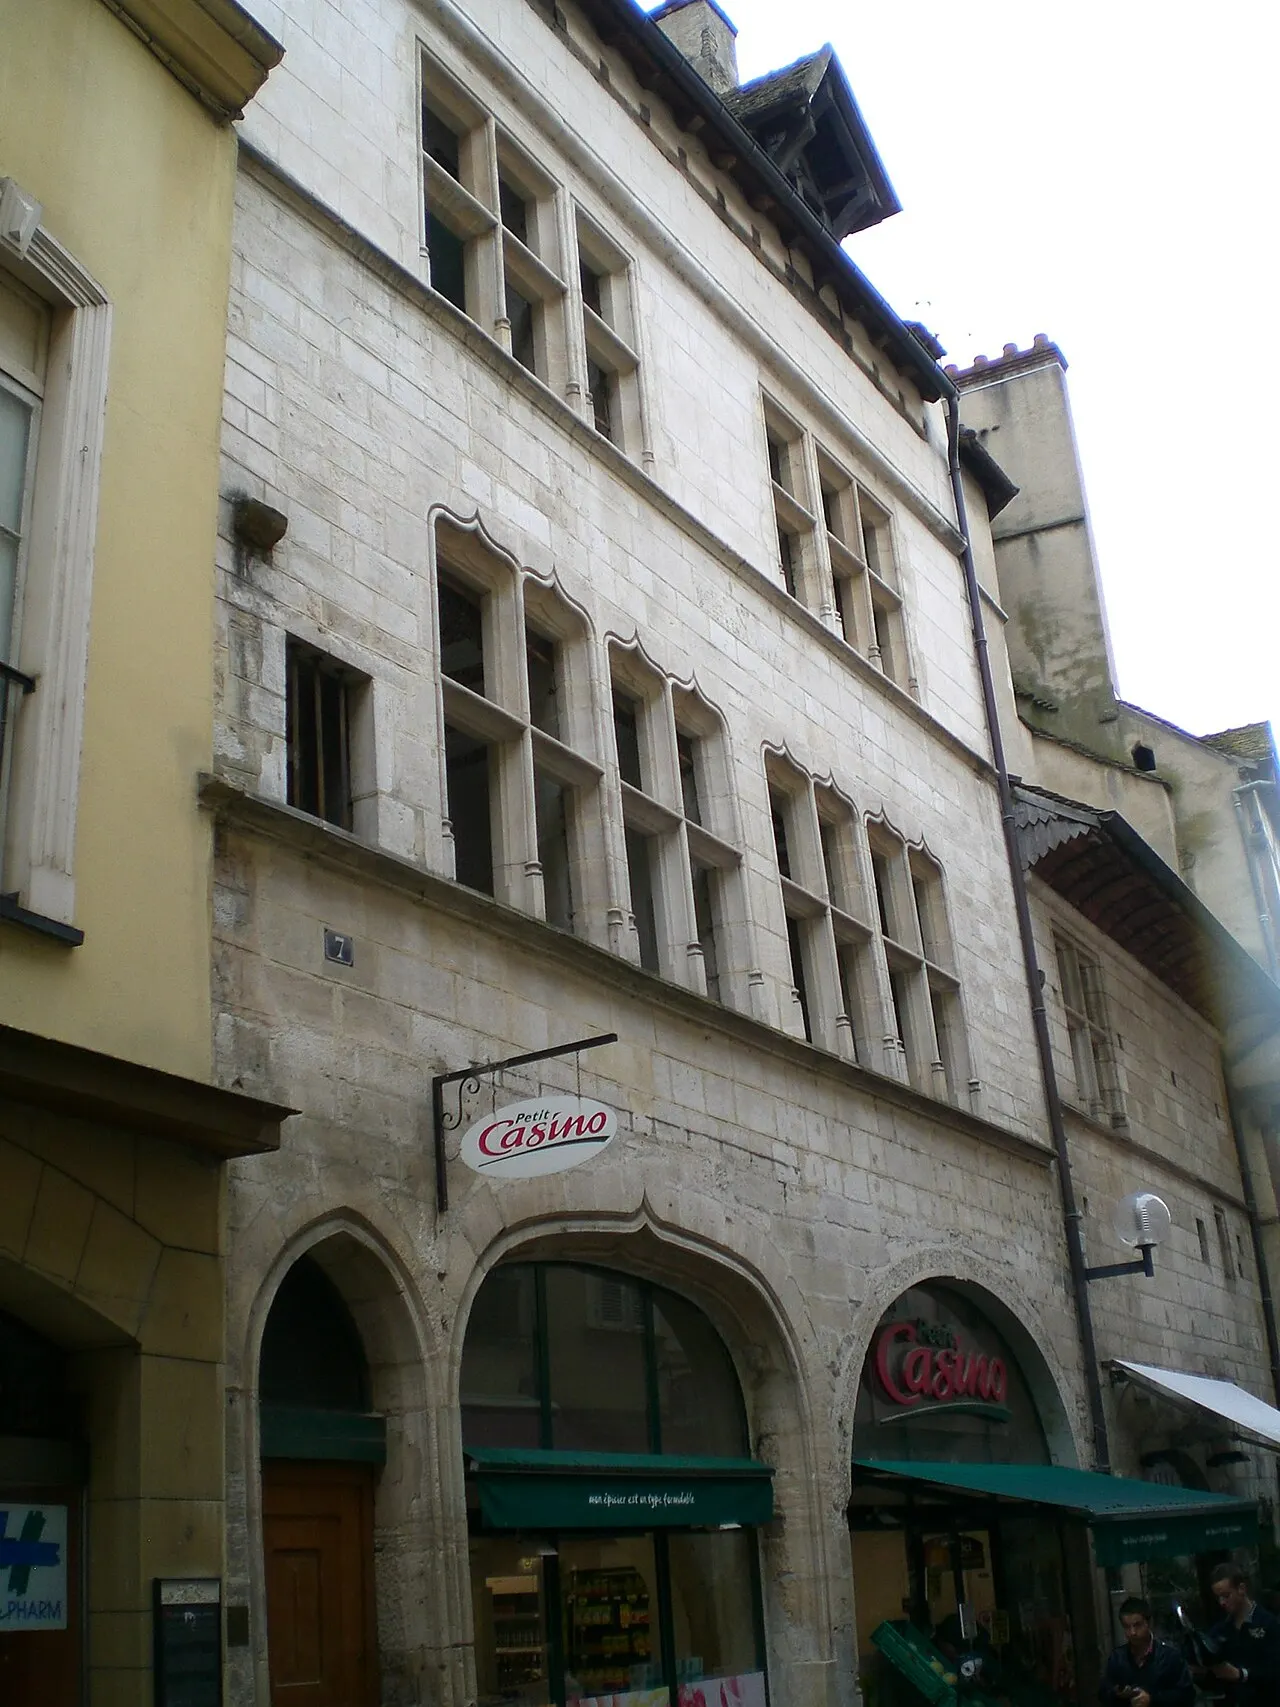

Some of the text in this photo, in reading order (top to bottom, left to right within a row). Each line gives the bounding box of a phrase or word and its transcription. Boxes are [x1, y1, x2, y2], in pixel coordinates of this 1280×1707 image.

[335, 936, 345, 959] 7
[478, 1111, 608, 1157] Casino
[515, 1109, 551, 1125] Petit
[876, 1323, 1007, 1406] Casino
